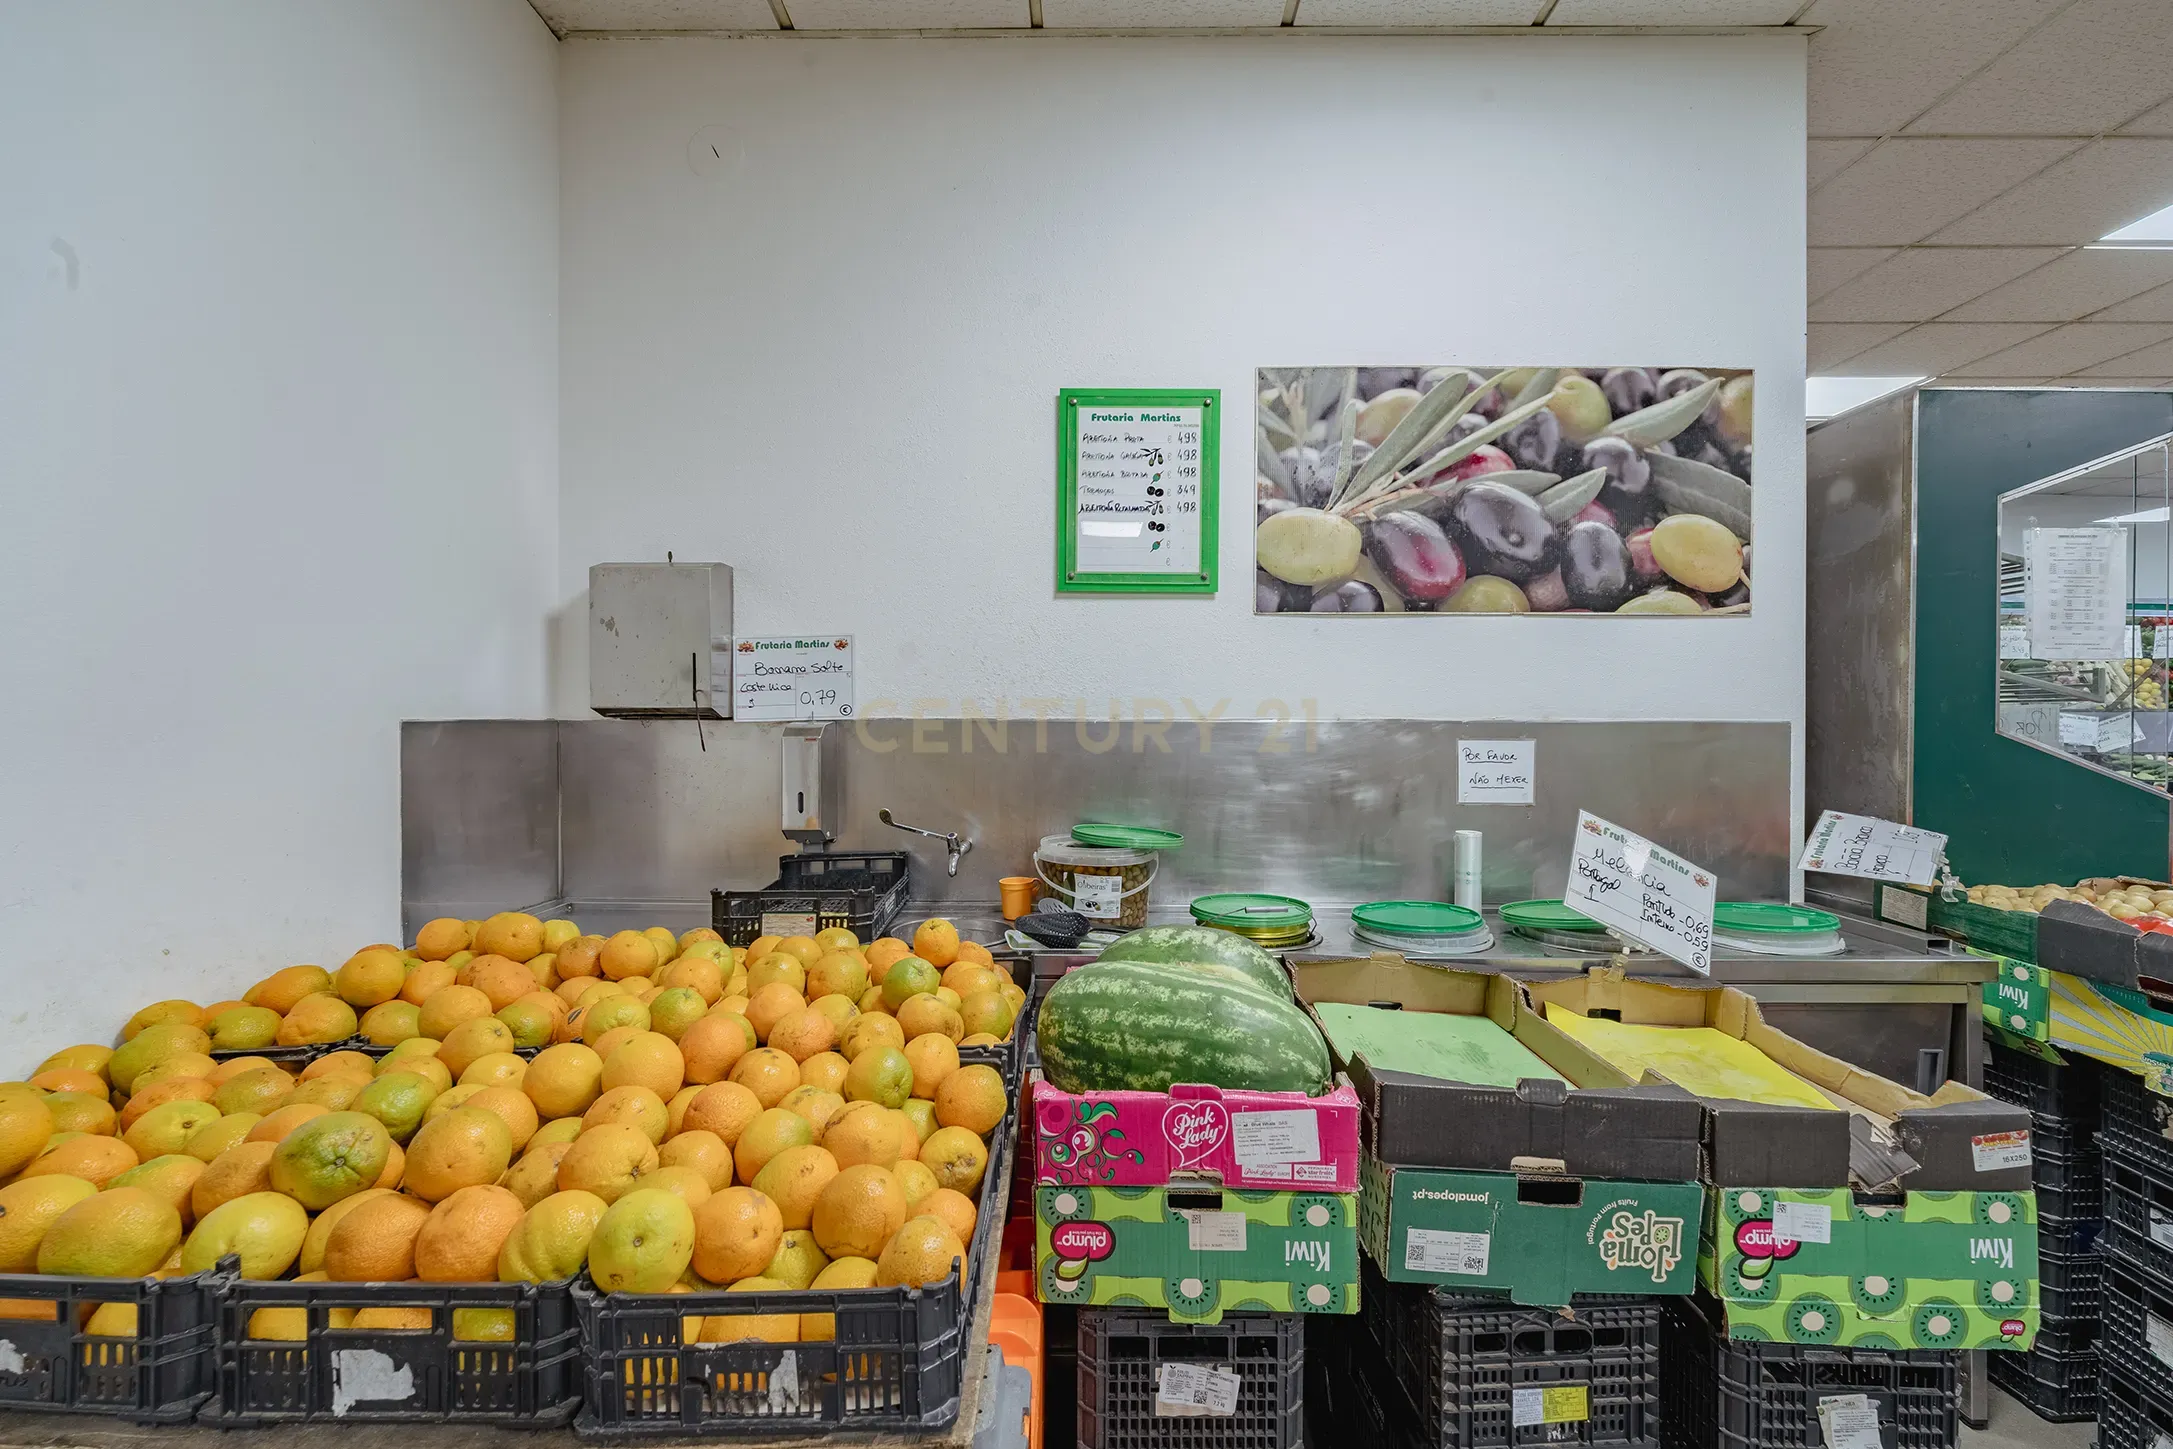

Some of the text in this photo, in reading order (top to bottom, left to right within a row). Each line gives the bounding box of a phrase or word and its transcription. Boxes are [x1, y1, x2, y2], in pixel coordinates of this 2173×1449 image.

[1091, 412, 1181, 422] Frutaria Martins
[755, 639, 830, 650] Frutaria Martins
[800, 689, 836, 705] 0,79
[1462, 747, 1518, 761] POR FAVOR
[1469, 772, 1528, 785] NÃO MEXER
[1649, 848, 1690, 876] Martins
[1998, 983, 2028, 1010] Kiwi
[1172, 1106, 1216, 1136] Pink
[1179, 1124, 1219, 1149] Lady
[1244, 1167, 1259, 1176] Pink
[1412, 1188, 1490, 1205] jomalopes.pt
[1586, 1199, 1639, 1245] Fruits from Portugal
[1061, 1231, 1106, 1251] plump
[1285, 1240, 1331, 1272] Kiwi
[1602, 1238, 1671, 1279] Joma
[1969, 1237, 2013, 1268] Kiwi
